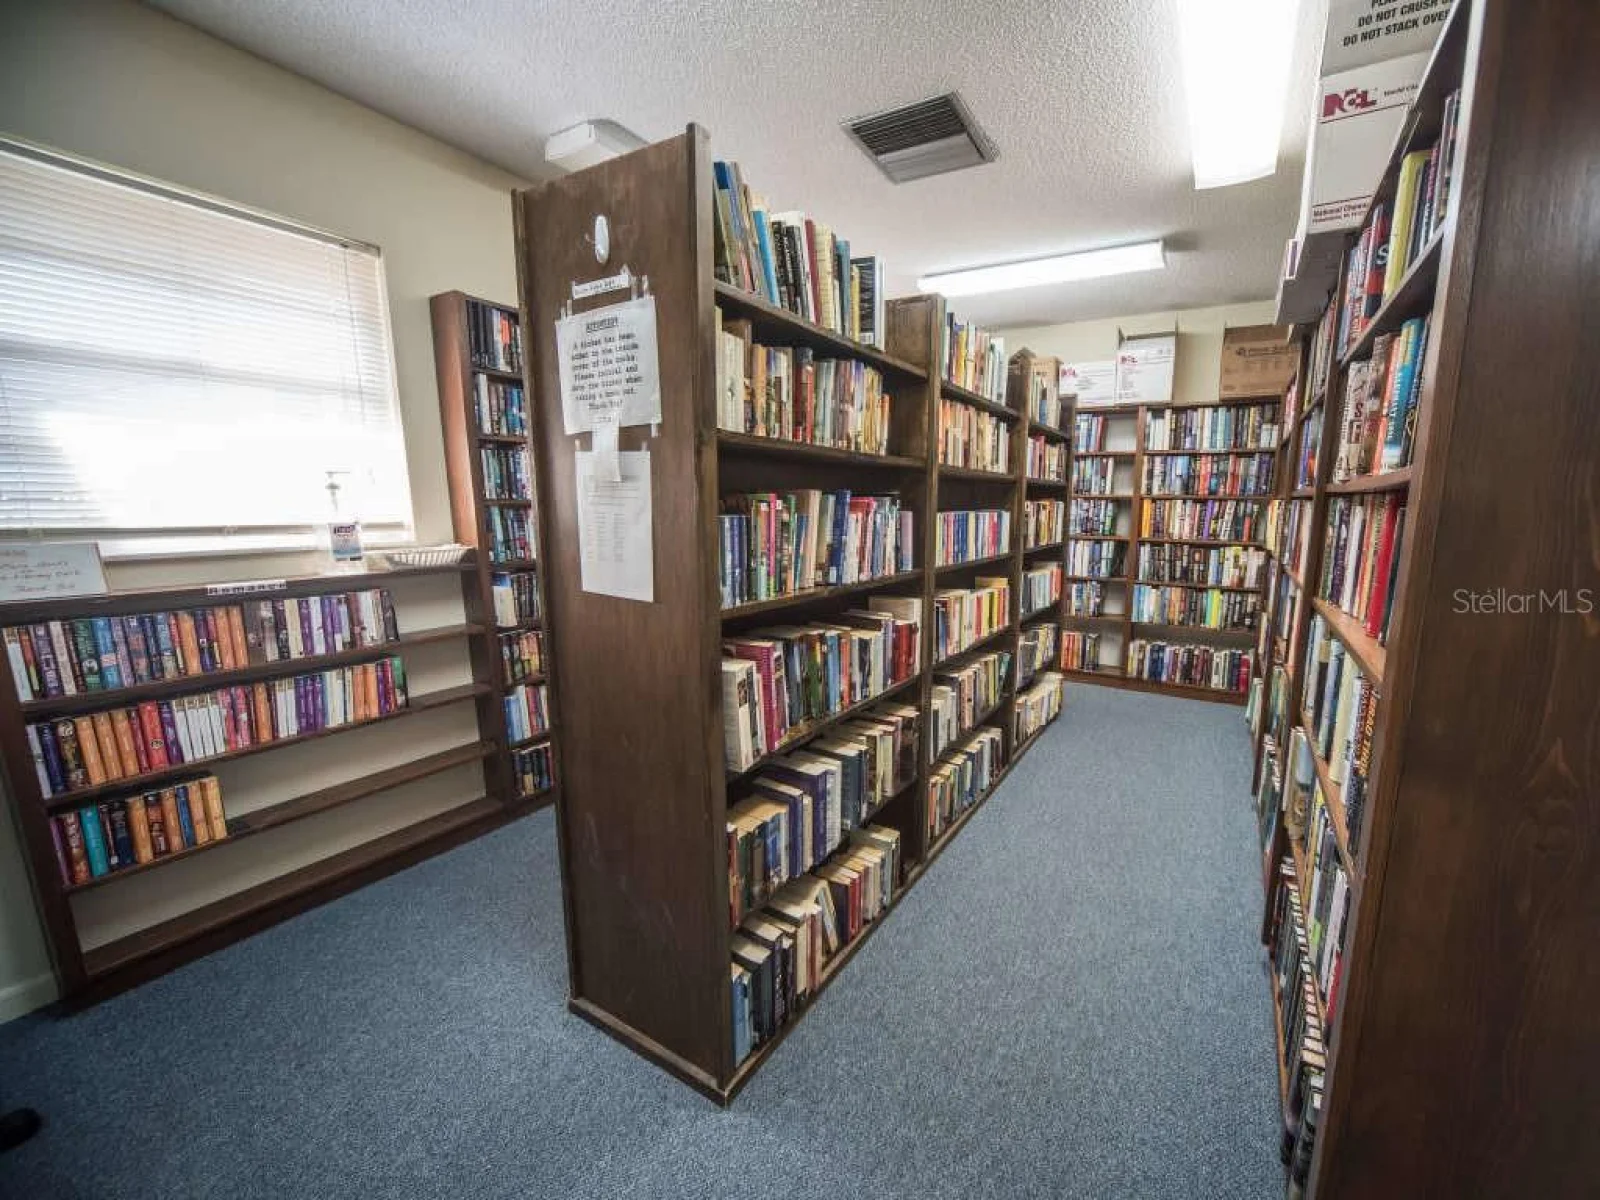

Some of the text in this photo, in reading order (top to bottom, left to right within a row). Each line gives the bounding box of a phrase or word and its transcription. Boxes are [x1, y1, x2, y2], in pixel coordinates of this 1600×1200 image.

[1358, 15, 1373, 27] DO
[1375, 8, 1398, 22] NOT
[1343, 34, 1358, 47] DO
[1361, 27, 1383, 43] NOT
[1385, 18, 1420, 35] STACK
